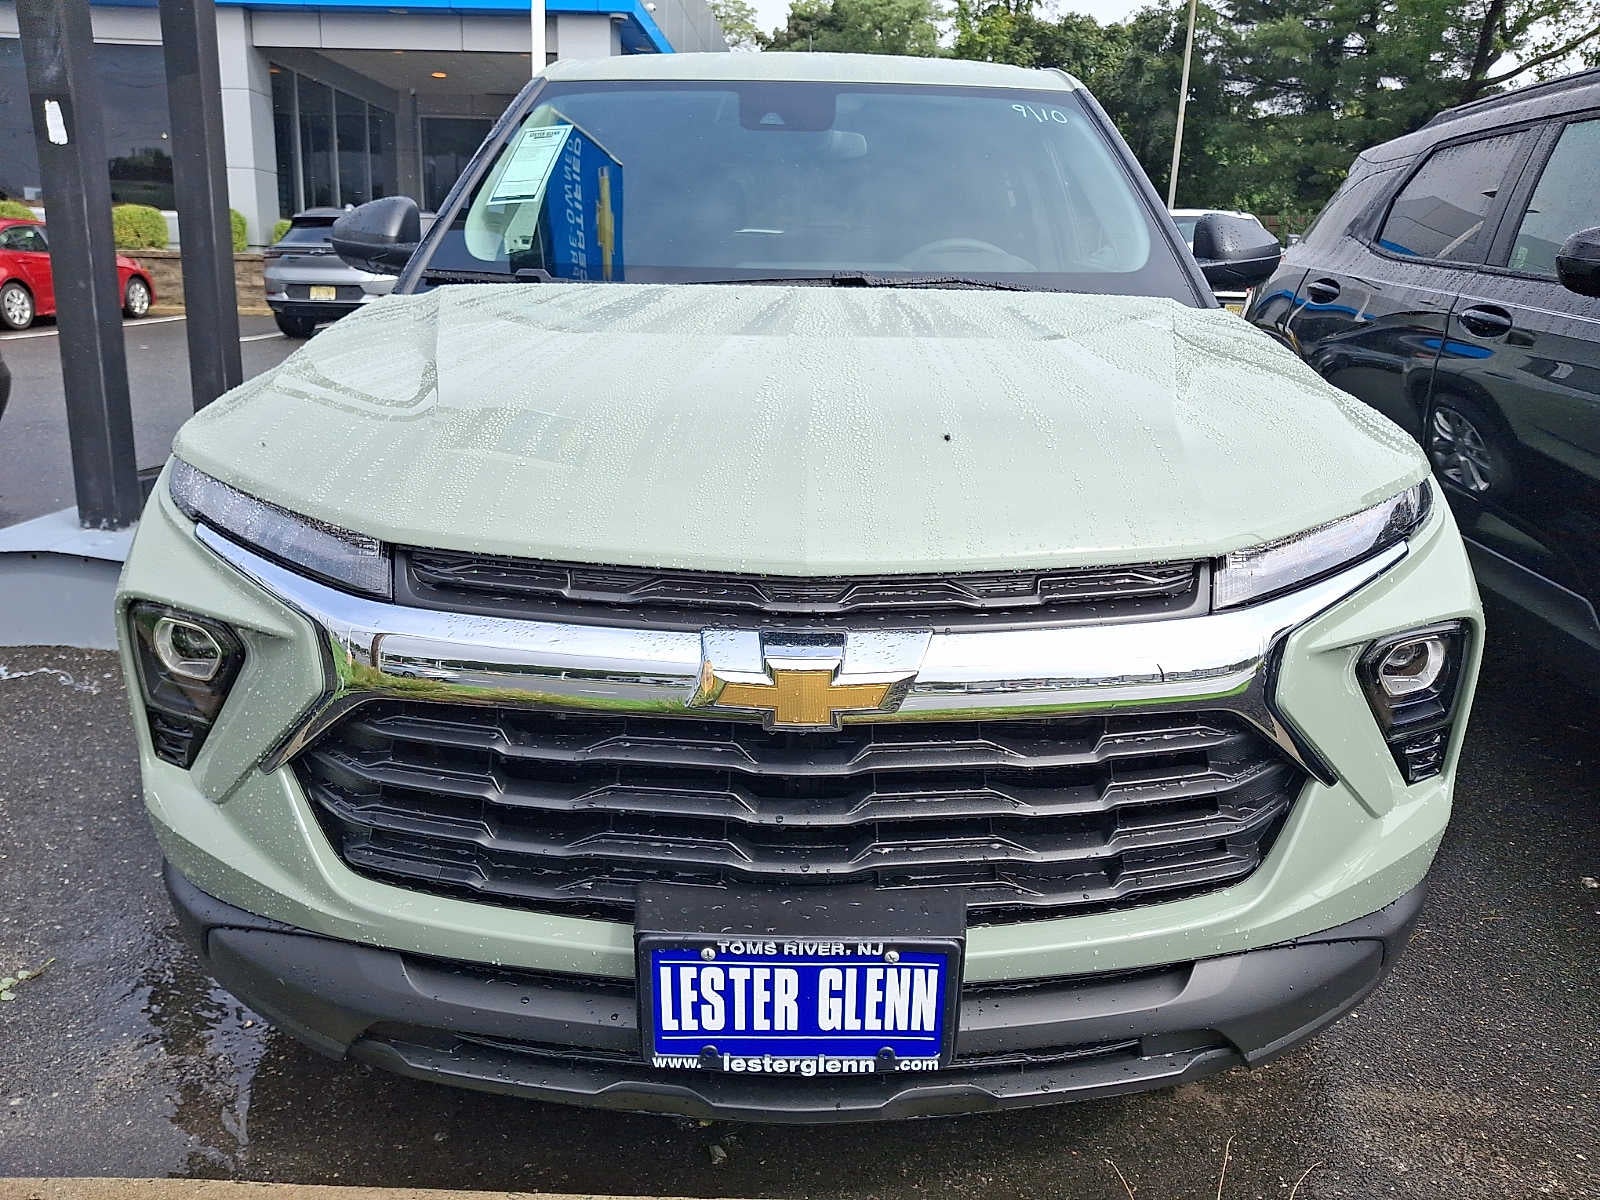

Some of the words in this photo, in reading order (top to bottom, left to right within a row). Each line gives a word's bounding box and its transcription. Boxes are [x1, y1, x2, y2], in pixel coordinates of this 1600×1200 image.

[716, 941, 776, 955] TOMS
[857, 942, 884, 956] NJ
[659, 966, 799, 1031] LESTER
[817, 967, 939, 1032] GLENN
[652, 1056, 702, 1069] www.
[723, 1055, 875, 1077] lesterglenn
[894, 1057, 939, 1071] .com
